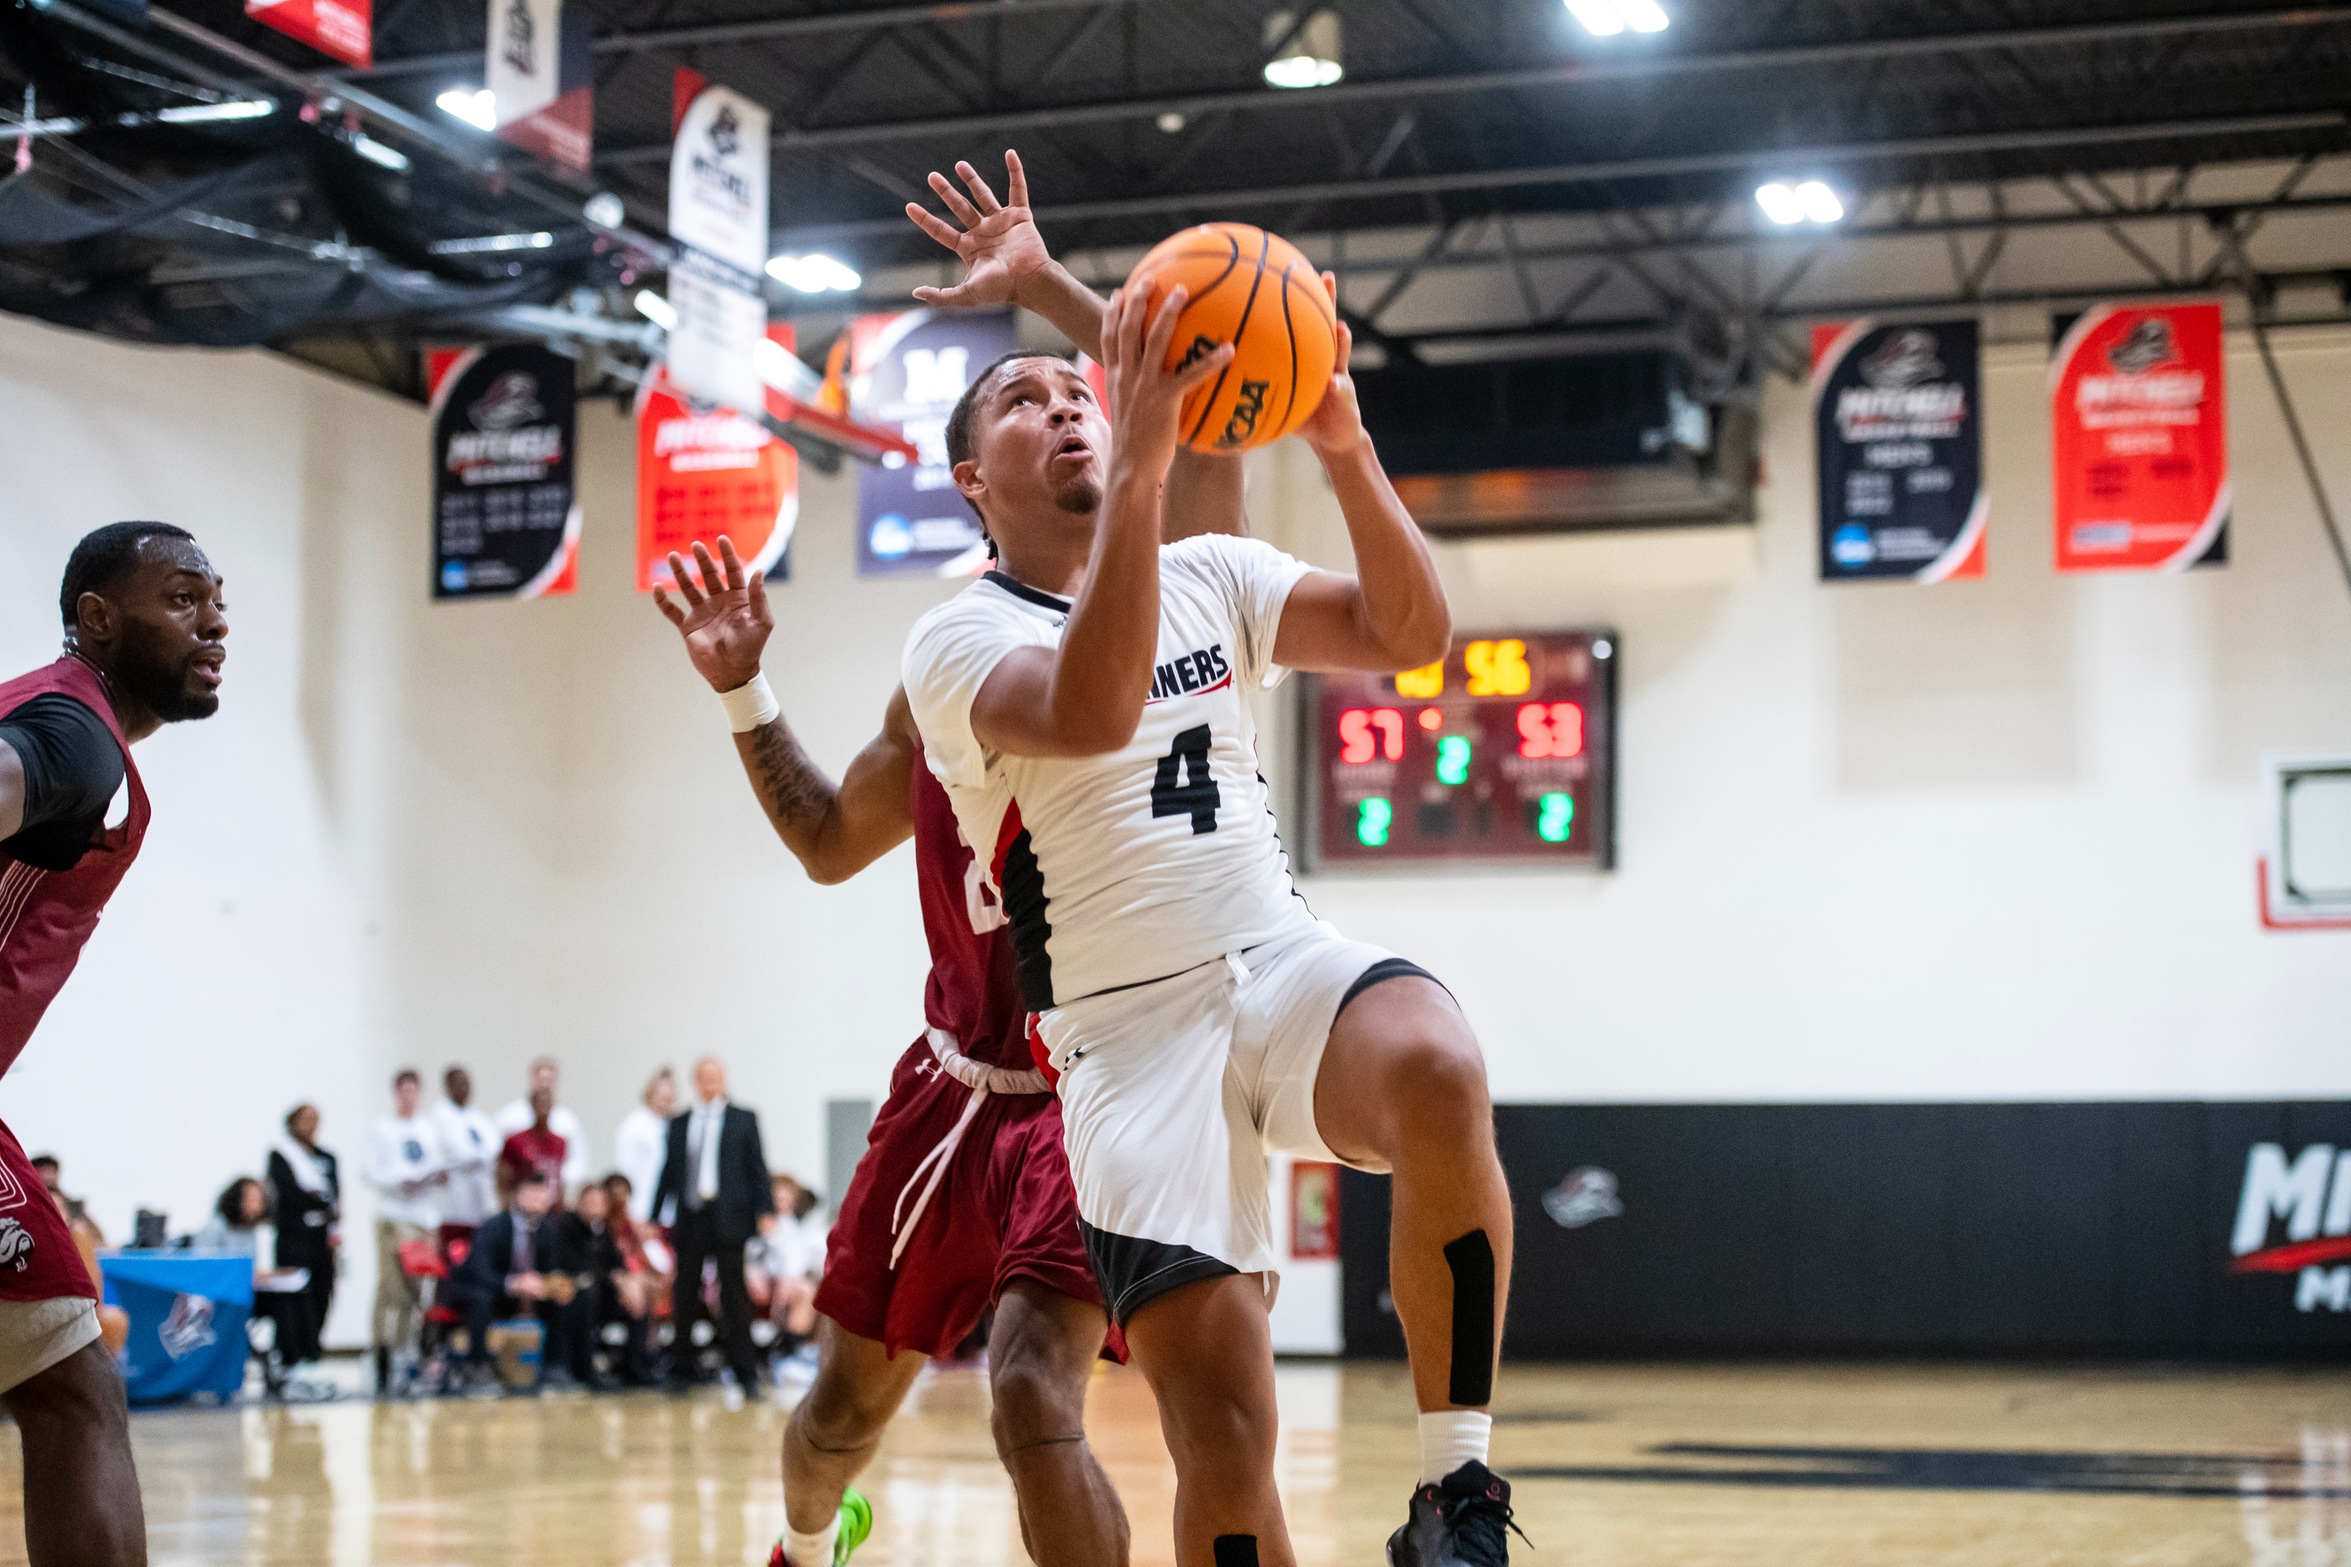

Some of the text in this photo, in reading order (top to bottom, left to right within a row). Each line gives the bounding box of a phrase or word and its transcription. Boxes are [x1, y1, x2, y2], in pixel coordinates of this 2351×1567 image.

[1147, 644, 1228, 699] INERS
[1464, 639, 1531, 696] 56
[1338, 708, 1405, 764] 57
[1516, 702, 1583, 759] 53
[1151, 723, 1220, 835] 4
[2294, 1265, 2351, 1312] M
